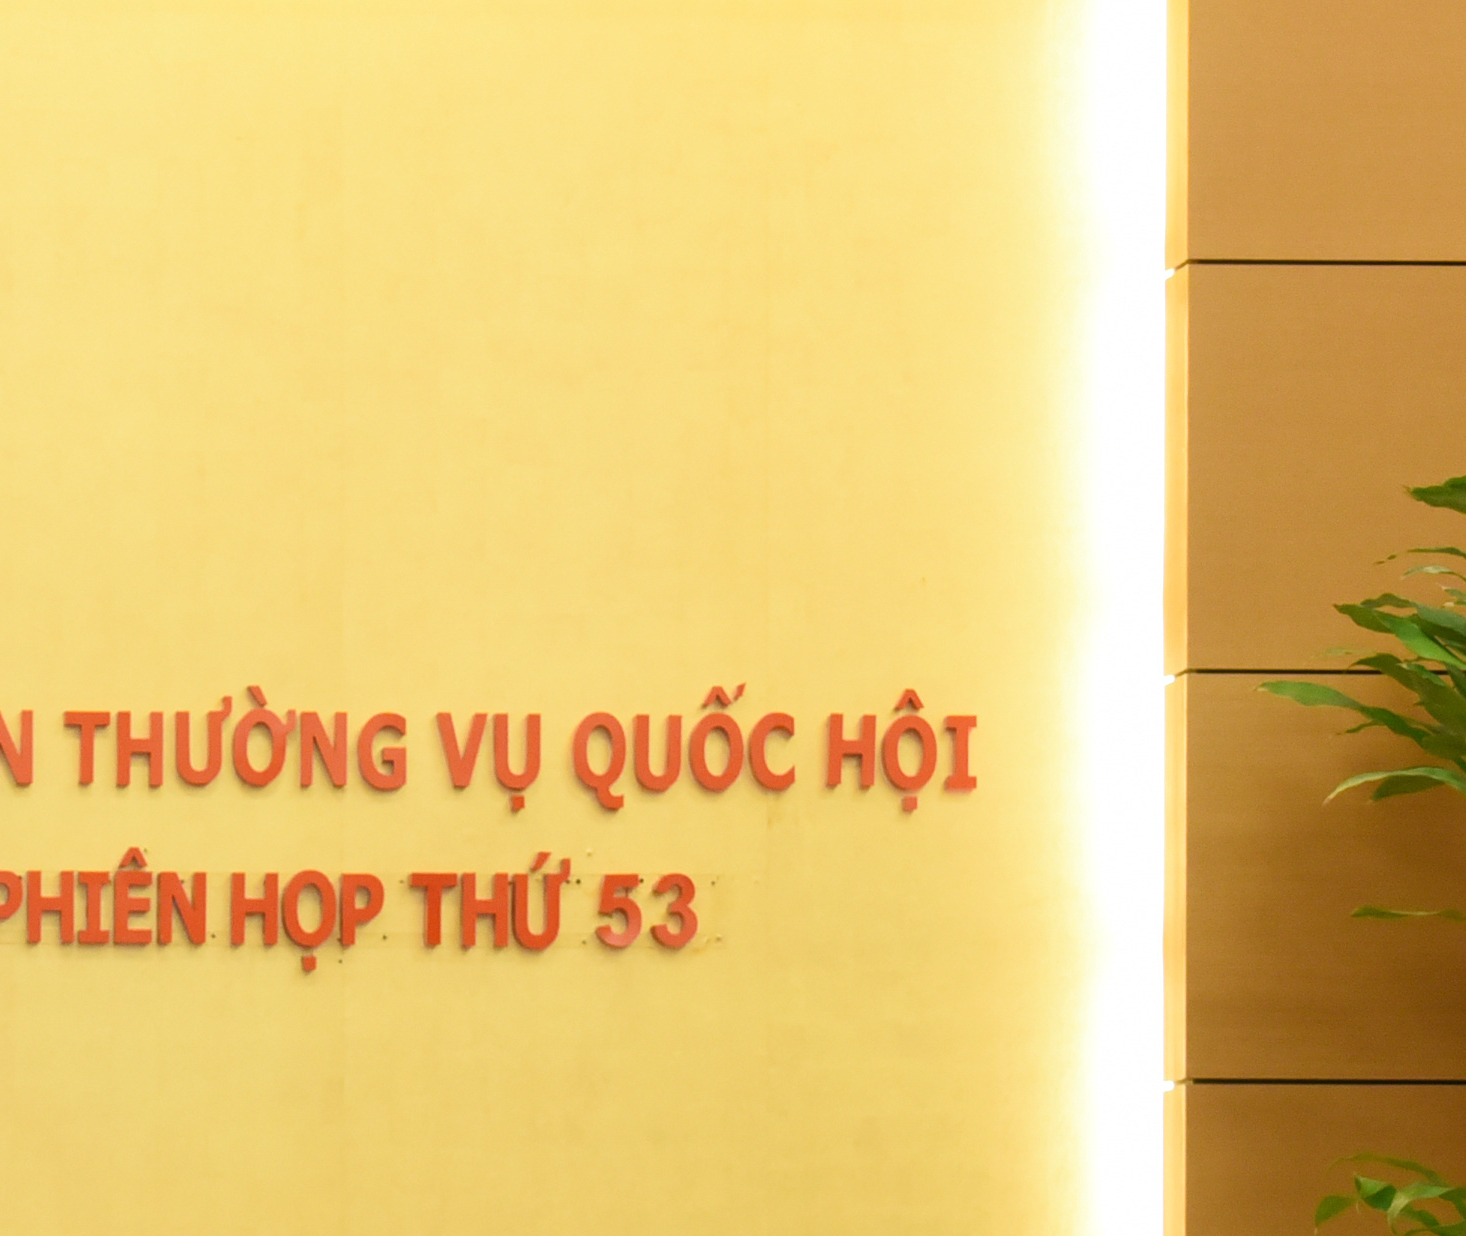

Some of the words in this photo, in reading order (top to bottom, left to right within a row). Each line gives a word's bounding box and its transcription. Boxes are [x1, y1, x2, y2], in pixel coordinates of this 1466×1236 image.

[63, 685, 408, 790] THƯỜNG
[436, 711, 542, 812] VỤ
[571, 683, 797, 811] QUỐC
[826, 689, 978, 813] HỘI
[230, 868, 386, 972] HỌP
[410, 851, 572, 952] THỨ
[596, 872, 699, 949] 53
